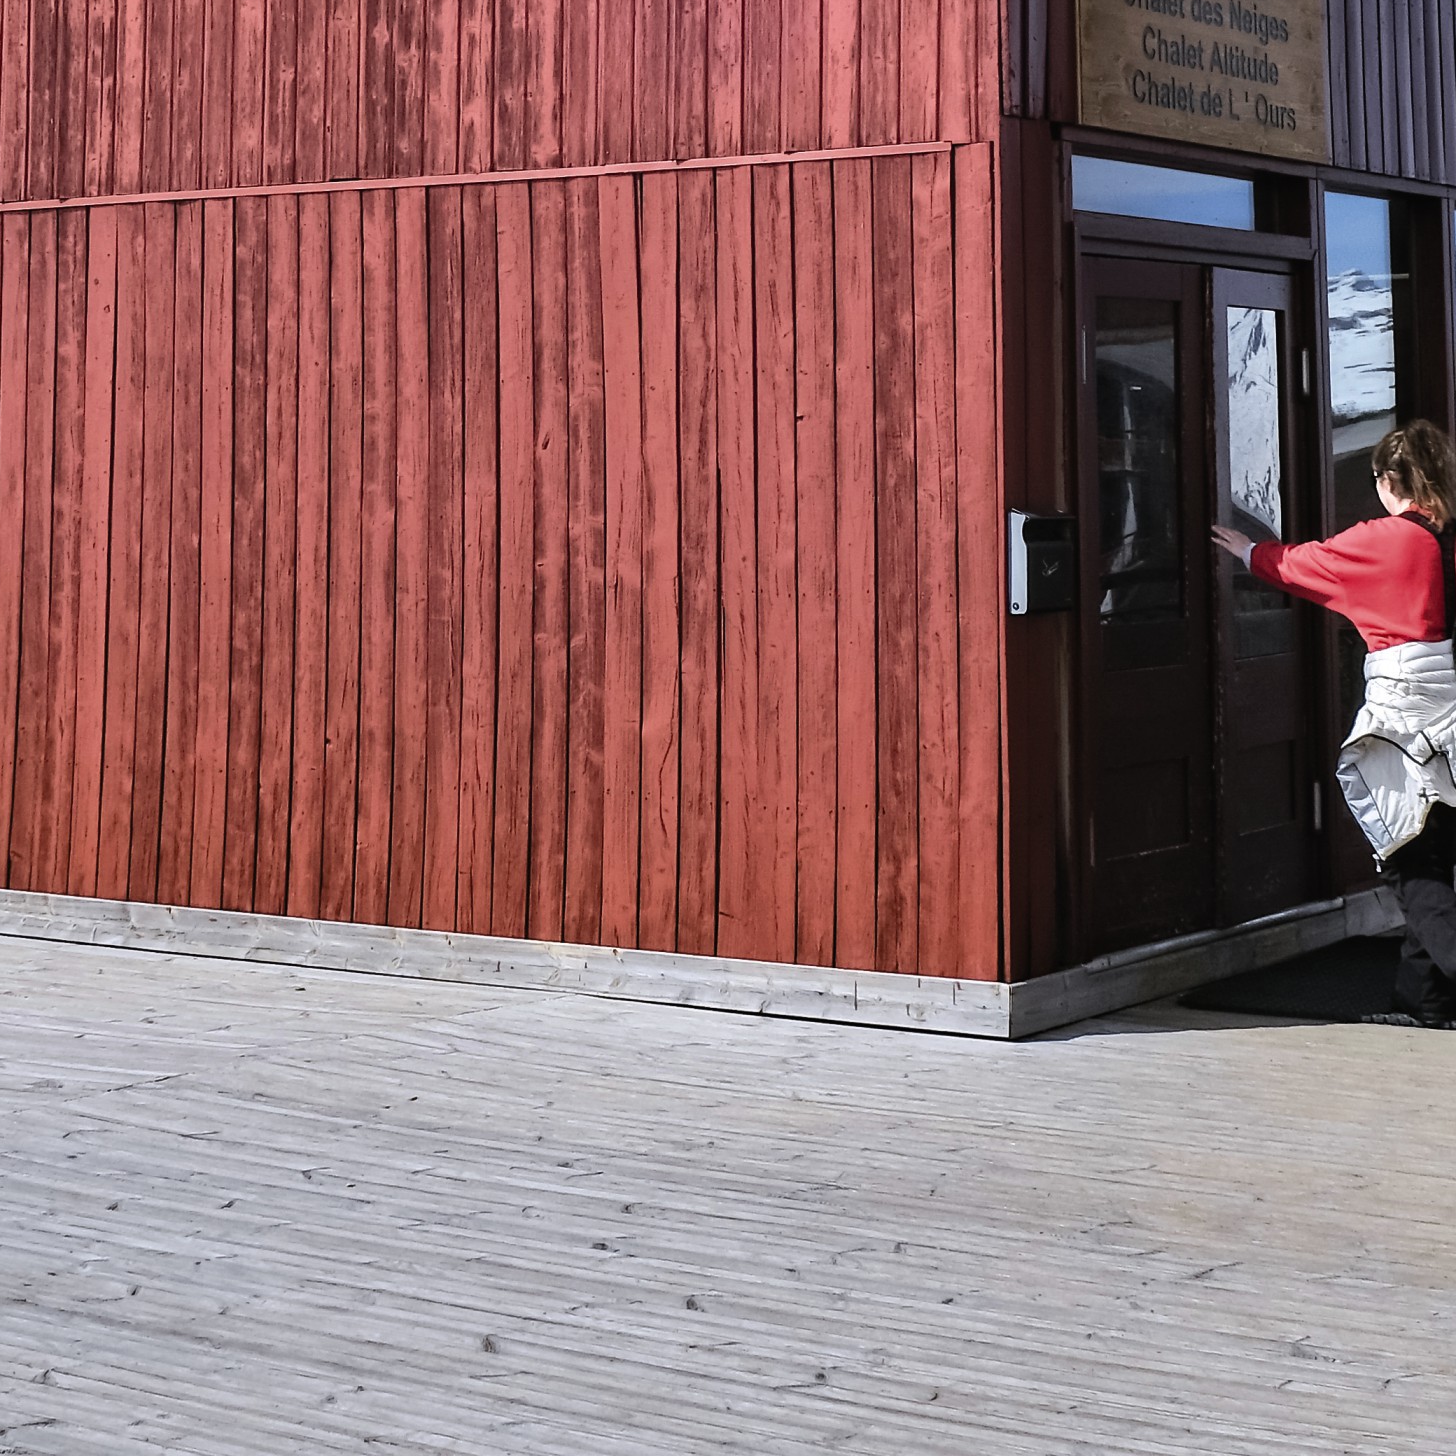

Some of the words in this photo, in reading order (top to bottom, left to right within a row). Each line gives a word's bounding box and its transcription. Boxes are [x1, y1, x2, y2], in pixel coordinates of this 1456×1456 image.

[1142, 25, 1204, 71] Chalet
[1209, 40, 1279, 86] Altitude
[1132, 69, 1195, 114] Chalet
[1200, 84, 1223, 118] de
